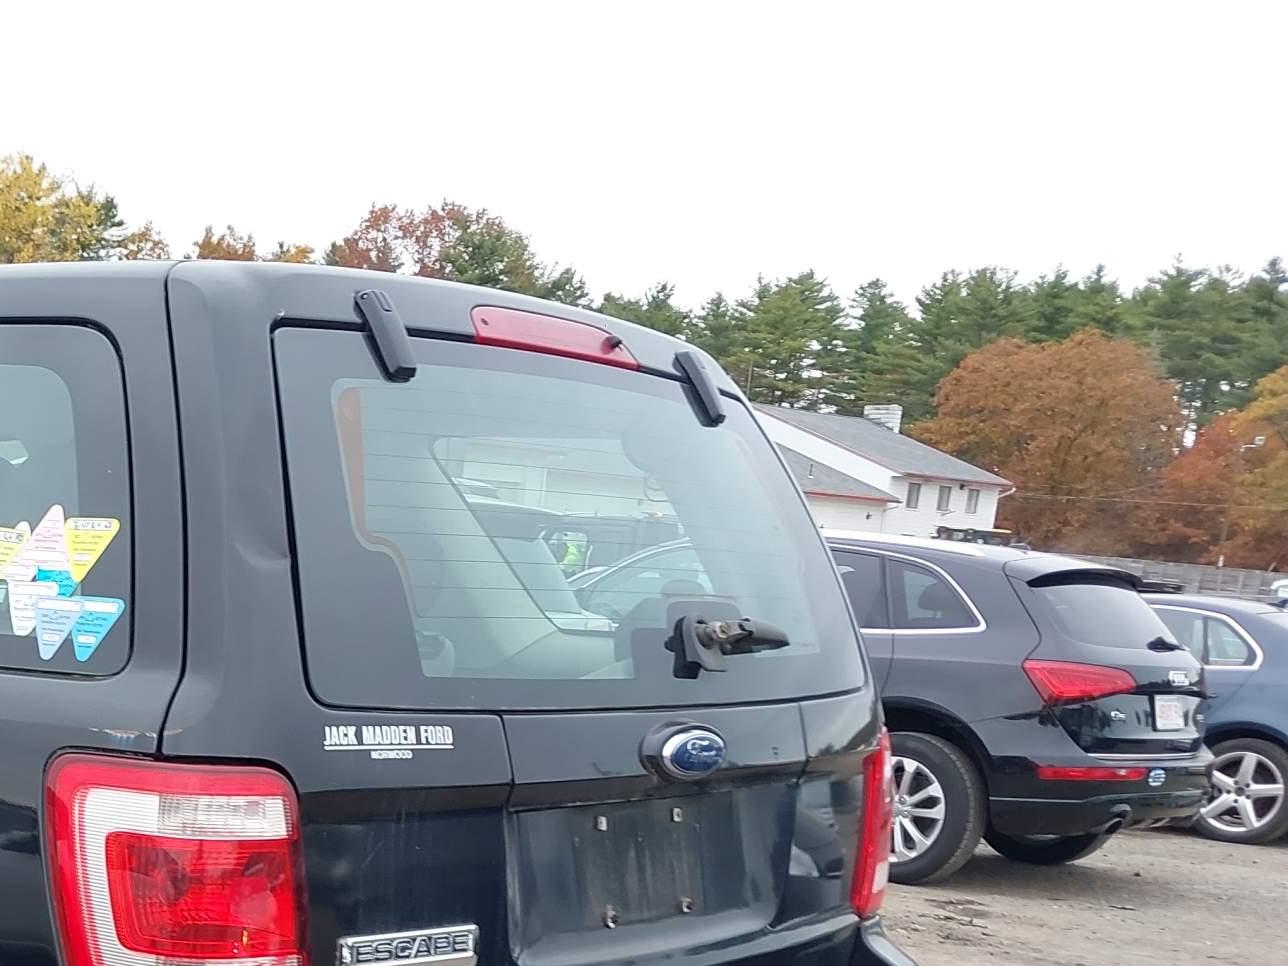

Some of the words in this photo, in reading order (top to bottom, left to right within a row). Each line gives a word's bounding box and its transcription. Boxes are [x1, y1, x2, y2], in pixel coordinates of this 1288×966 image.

[323, 725, 359, 746] JACK
[362, 725, 417, 745] MADDEN
[419, 725, 454, 744] FORD
[351, 931, 470, 964] ESCAPE
